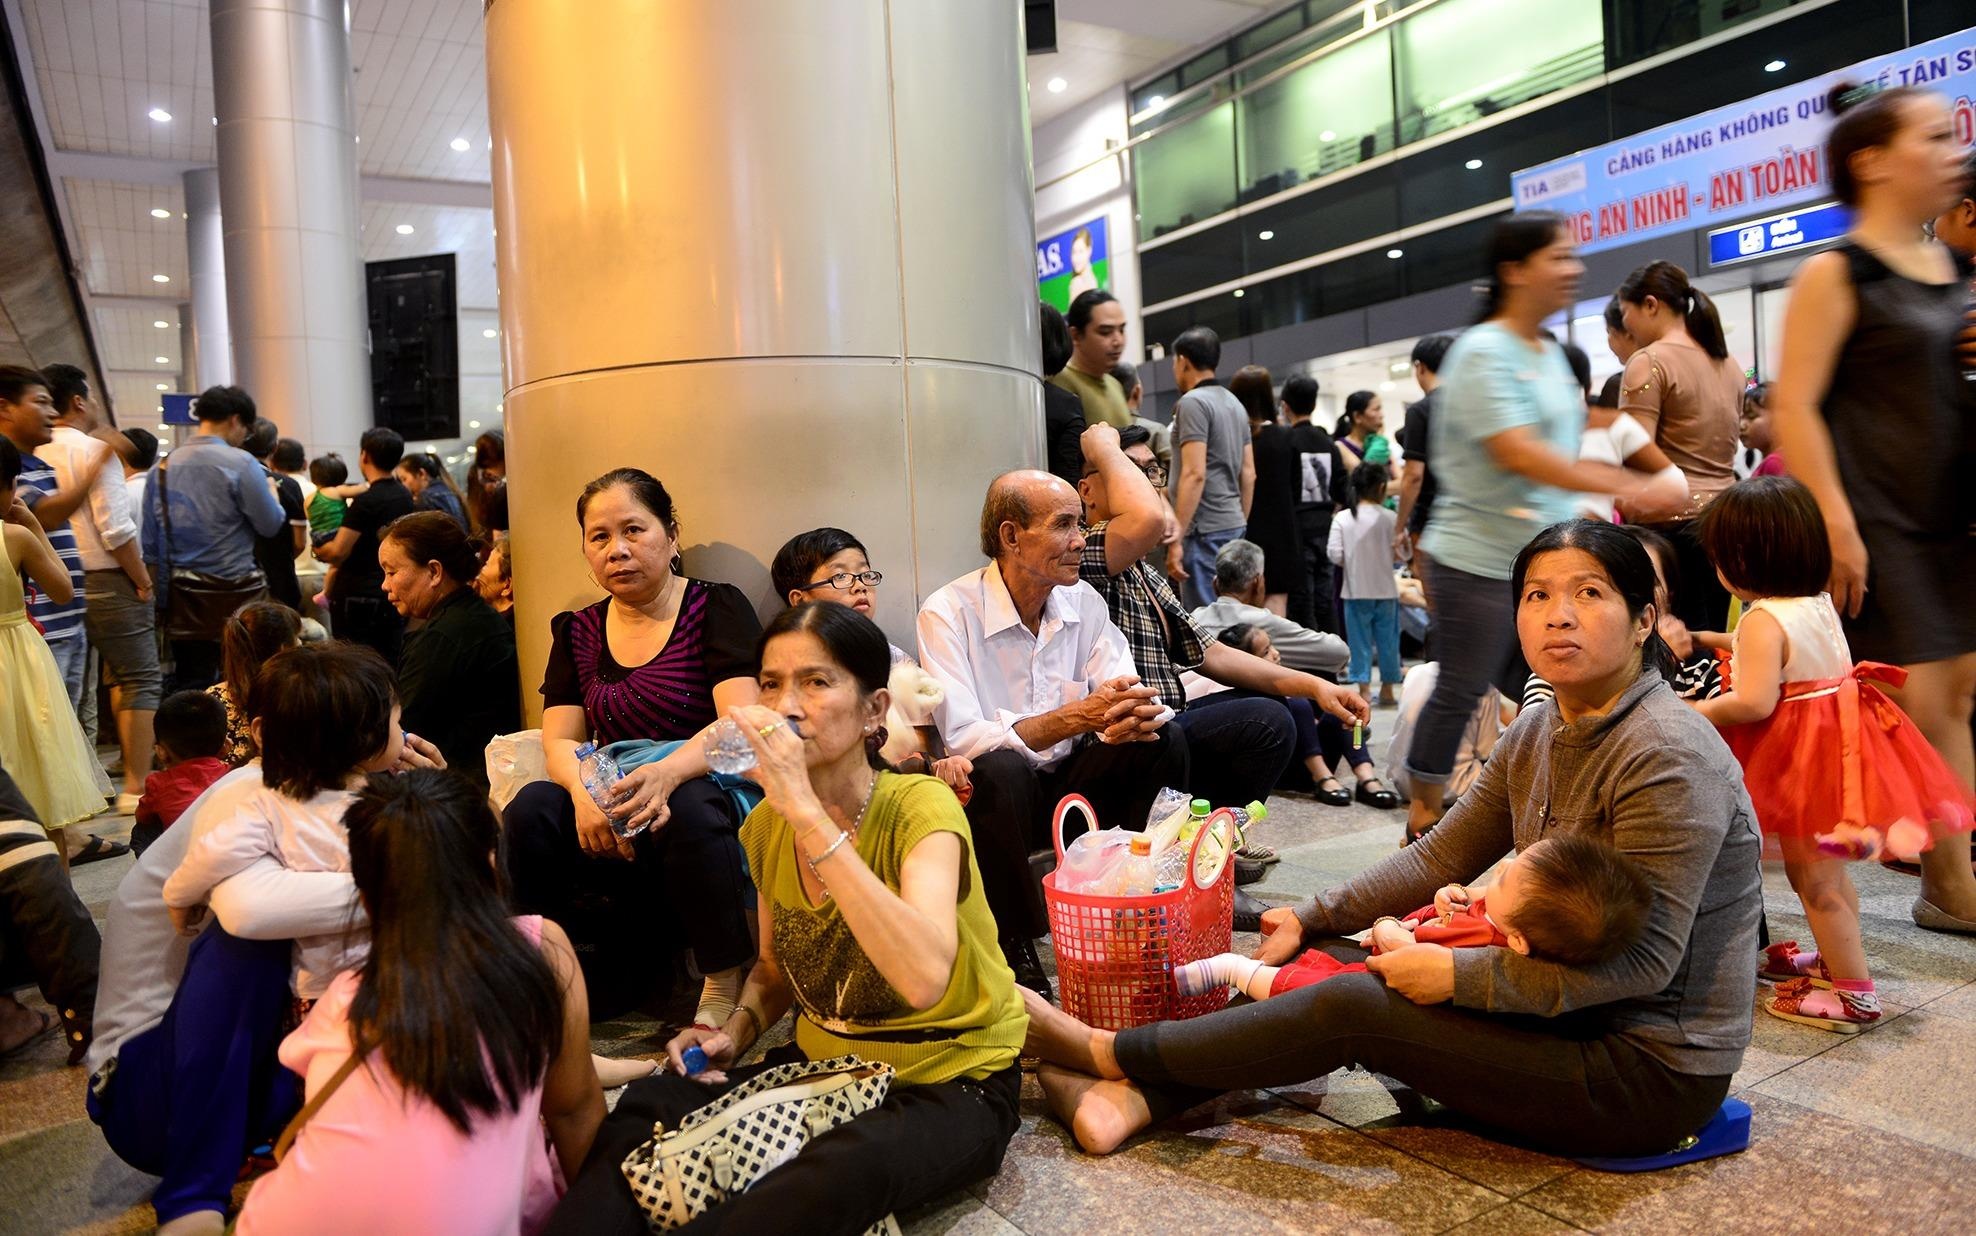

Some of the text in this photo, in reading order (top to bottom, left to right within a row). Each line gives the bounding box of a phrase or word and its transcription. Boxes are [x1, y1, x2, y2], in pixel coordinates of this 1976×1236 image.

[1608, 147, 1655, 175] CẢNG
[1662, 131, 1712, 159] HÀNG
[1720, 107, 1789, 142] KHÔNG
[1797, 95, 1825, 119] QU
[1899, 57, 1947, 86] TÂN
[1957, 49, 1976, 71] S
[1522, 180, 1549, 199] TIA
[1599, 201, 1628, 238] AN
[1632, 186, 1688, 228] NINH
[1711, 170, 1744, 210] AN
